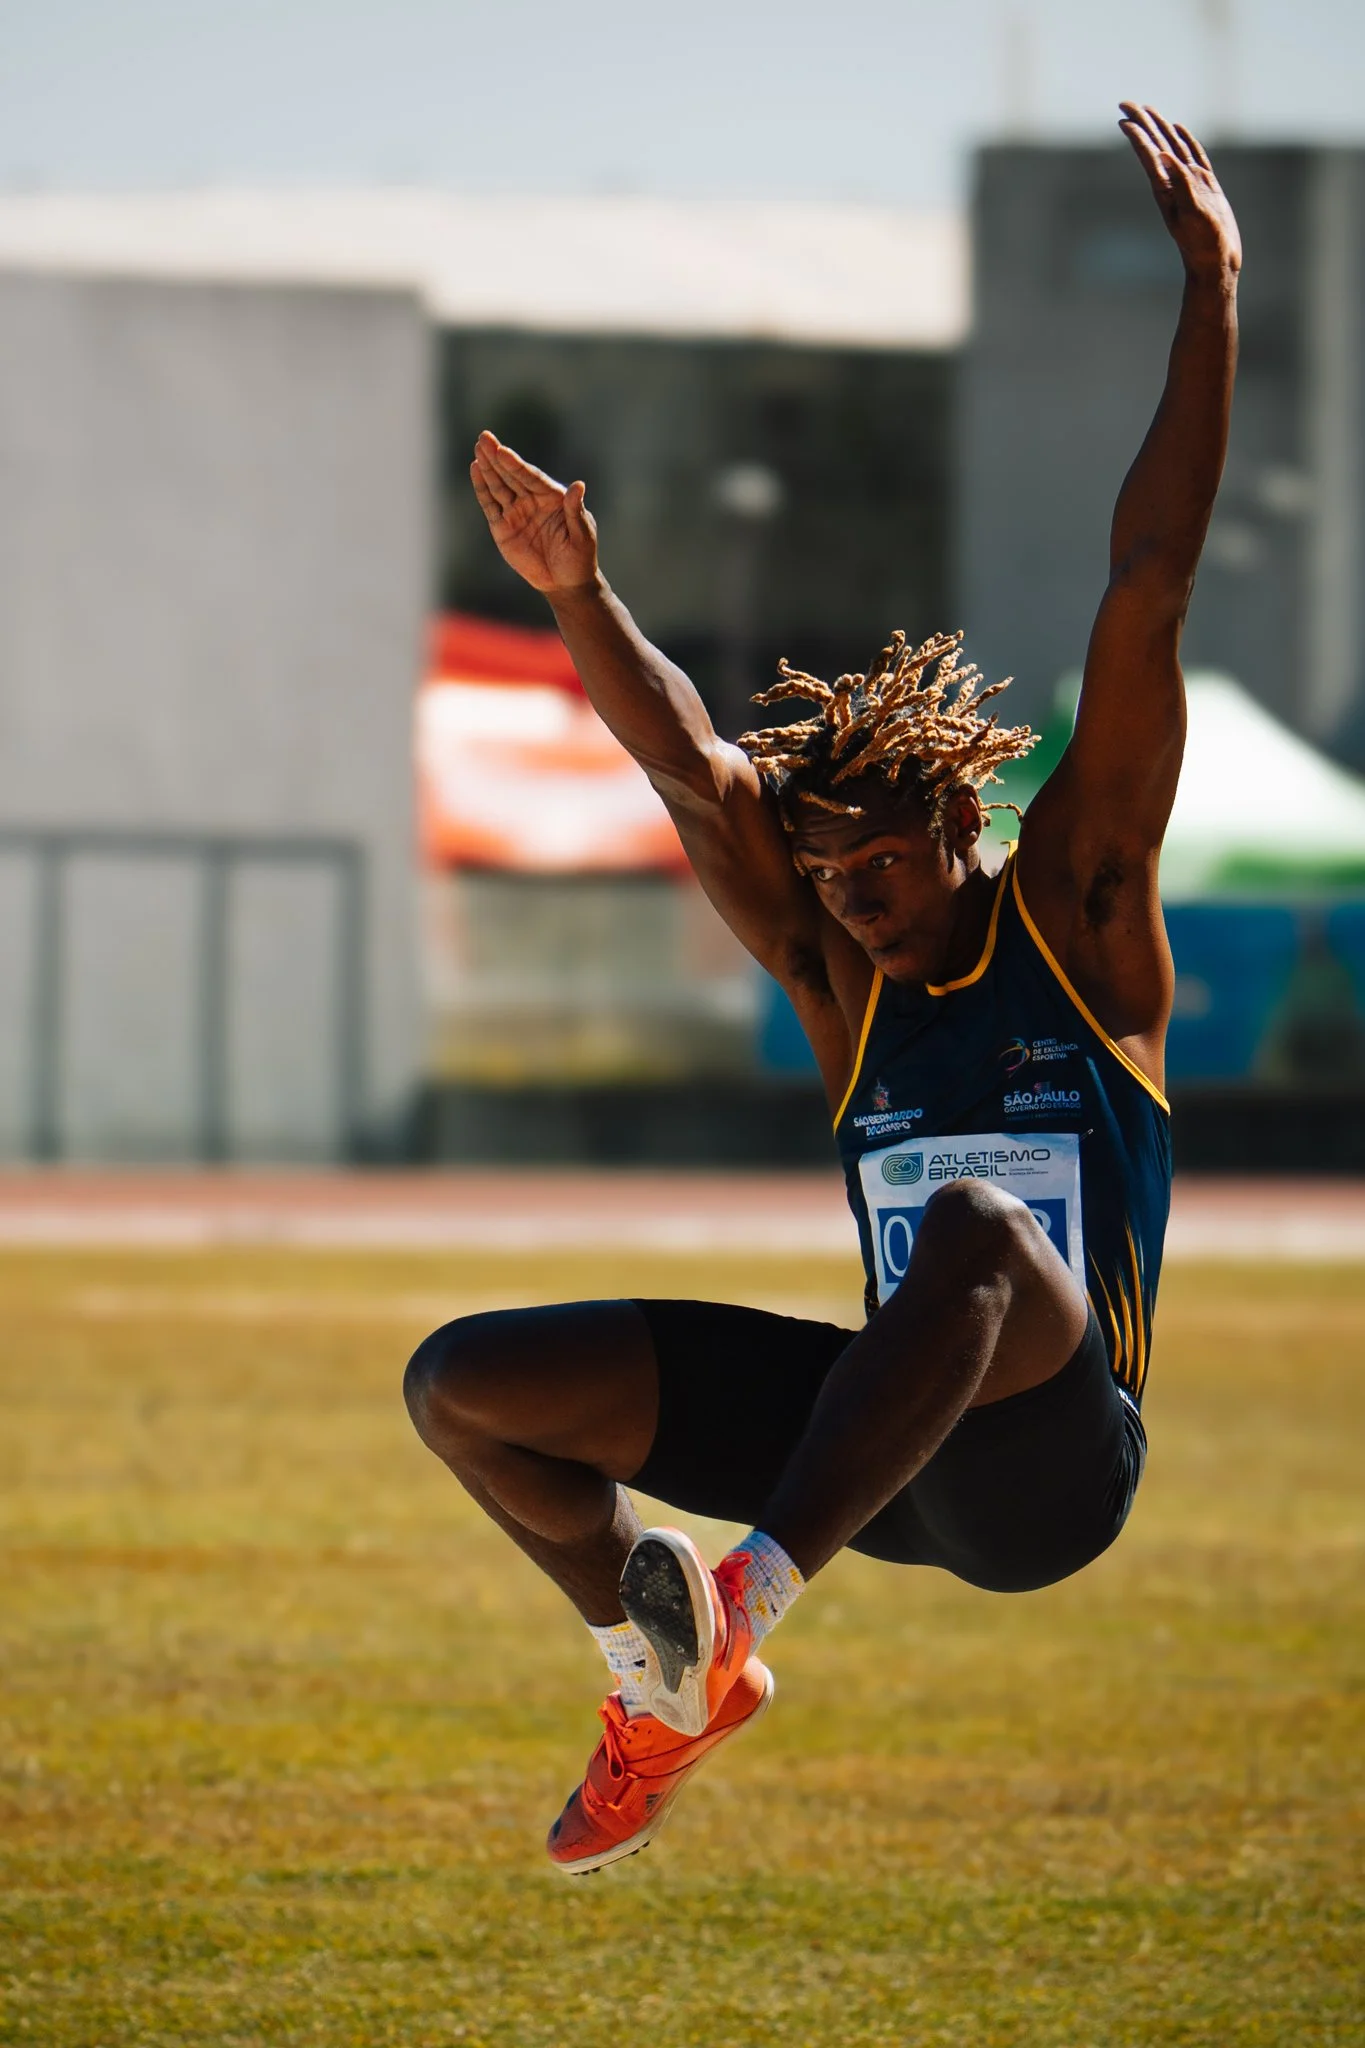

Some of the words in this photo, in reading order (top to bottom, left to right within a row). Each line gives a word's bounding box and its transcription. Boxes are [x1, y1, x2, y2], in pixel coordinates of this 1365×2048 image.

[1032, 1038, 1057, 1048] CENTRO
[1032, 1053, 1068, 1061] ESPORTIVA
[1003, 1090, 1033, 1107] SÃO
[1035, 1089, 1081, 1103] PAULO
[1004, 1103, 1040, 1113] GOVERNO
[1053, 1101, 1081, 1109] ESTADO
[928, 1149, 1051, 1167] ATLETISMO
[928, 1164, 1007, 1181] BRASIL
